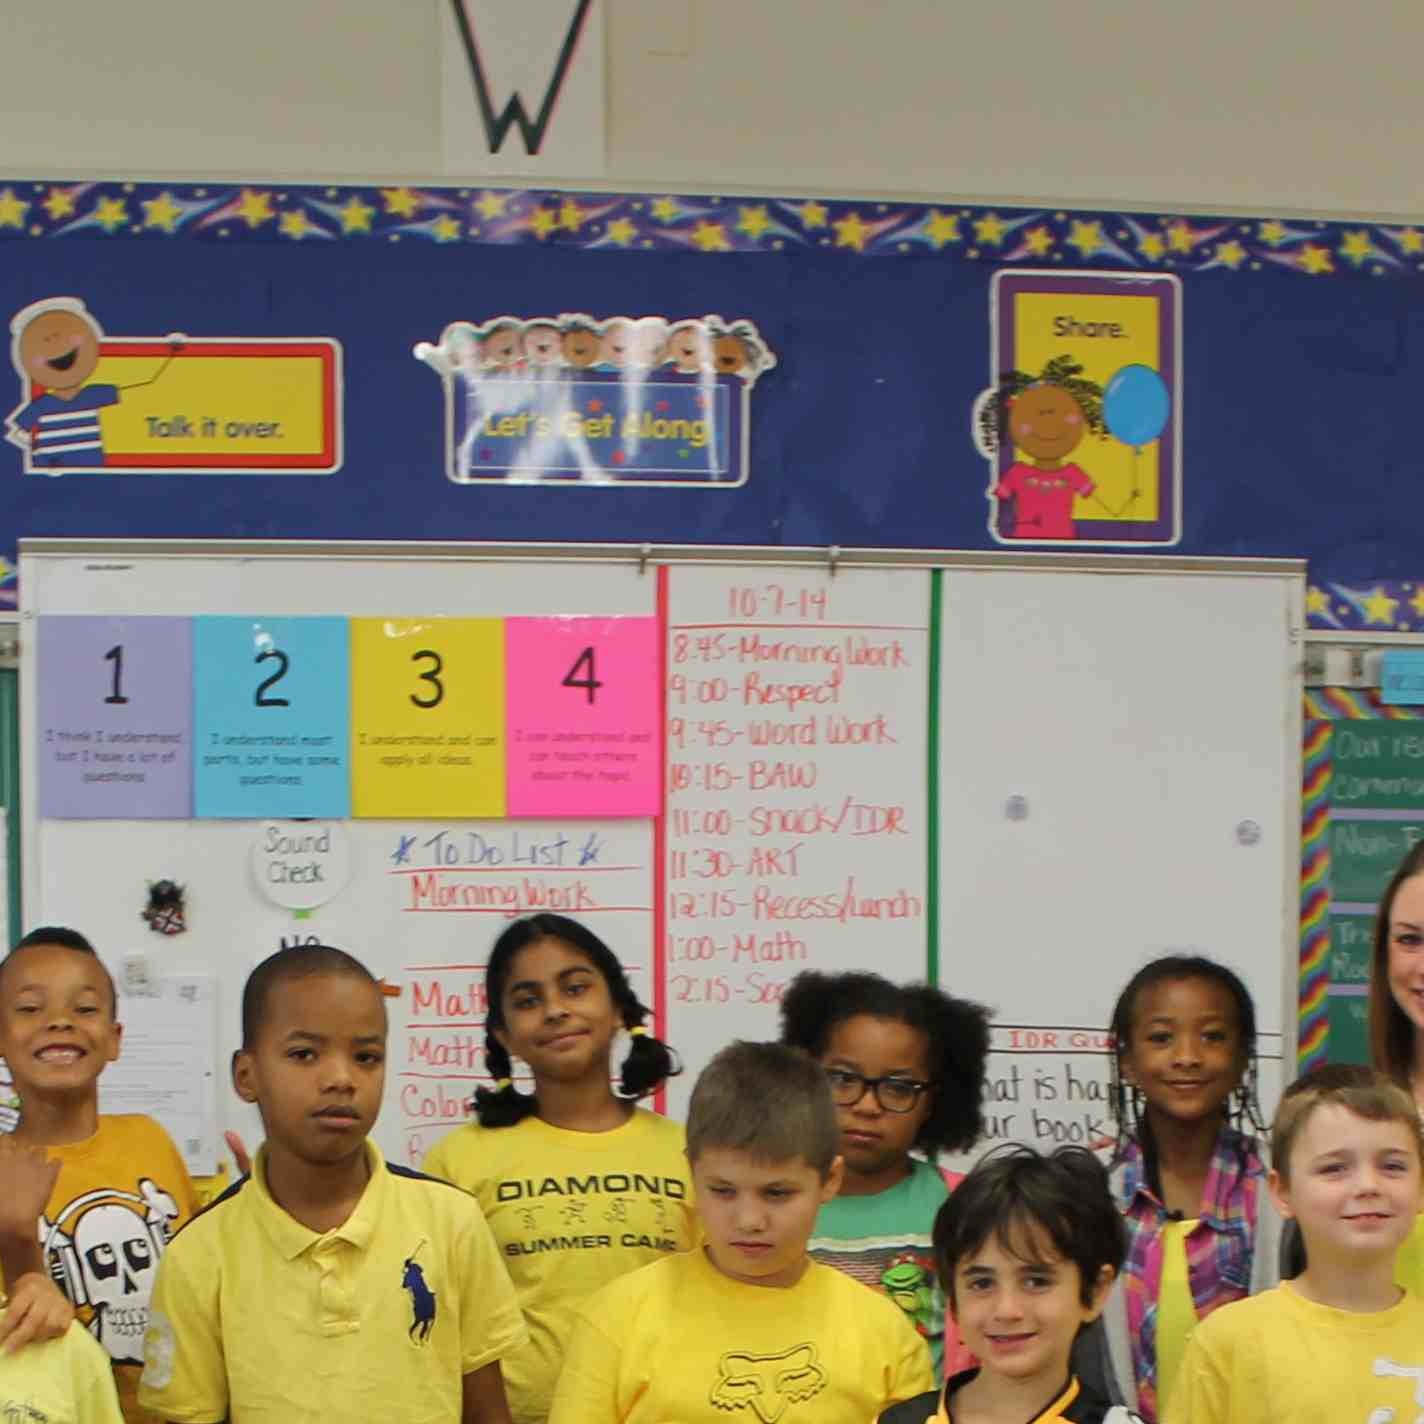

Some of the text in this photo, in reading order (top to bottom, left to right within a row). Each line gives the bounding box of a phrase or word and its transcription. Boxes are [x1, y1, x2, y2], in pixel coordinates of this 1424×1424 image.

[452, 0, 589, 154] W
[1052, 314, 1129, 341] Share.
[144, 414, 284, 441] Talk it over.
[560, 411, 614, 438] Get
[621, 411, 709, 447] Along
[845, 636, 912, 669] Work
[104, 644, 129, 704] 1
[253, 648, 291, 708] 2
[409, 649, 445, 709] 3
[561, 645, 603, 705] 4
[826, 713, 899, 746] Work
[265, 827, 332, 855] Sound
[425, 831, 457, 865] To
[466, 832, 502, 865] Do
[411, 872, 597, 918] Morning Work
[1009, 1029, 1057, 1050] IDR
[1032, 1068, 1058, 1102] is
[1031, 1108, 1106, 1143] book
[497, 1173, 687, 1203] DIAMOND
[505, 1235, 612, 1257] SUMMER
